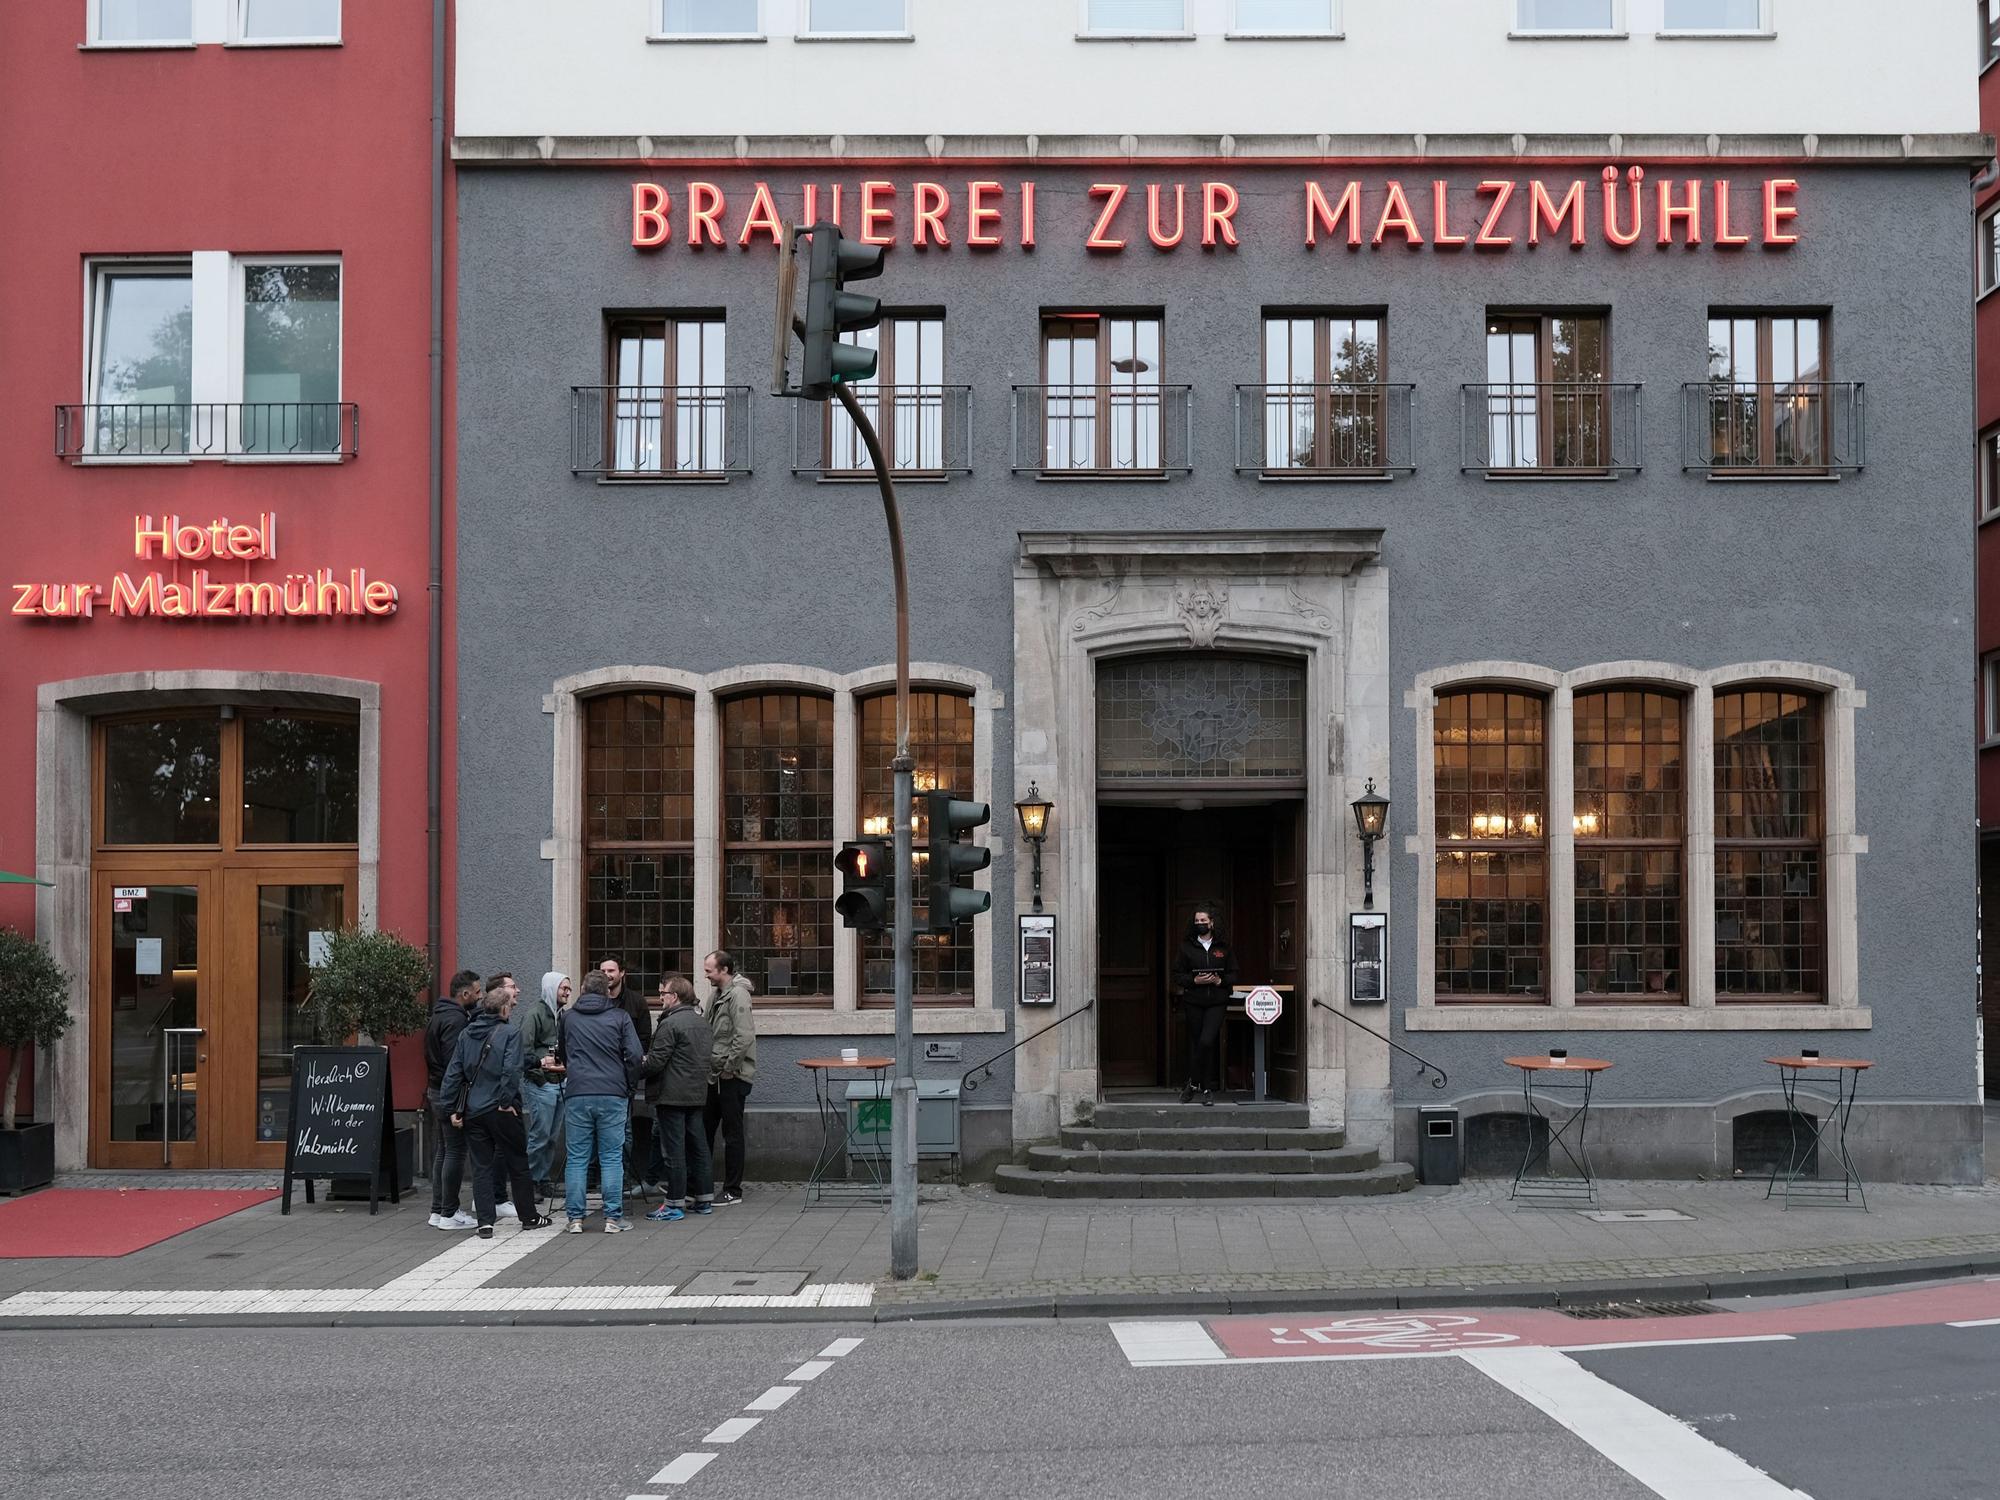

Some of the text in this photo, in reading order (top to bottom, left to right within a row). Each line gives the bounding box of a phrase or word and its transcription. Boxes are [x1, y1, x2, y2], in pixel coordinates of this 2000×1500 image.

[631, 165, 1800, 250] BRAUEREI ZUR MALZMÜHLE
[135, 511, 276, 560] Hotel
[11, 567, 399, 617] zur Malzmühle
[307, 1060, 353, 1089] Herzlich
[311, 1093, 375, 1116] Willkommen
[331, 1114, 365, 1128] in der
[295, 1127, 359, 1157] Malzmühle
